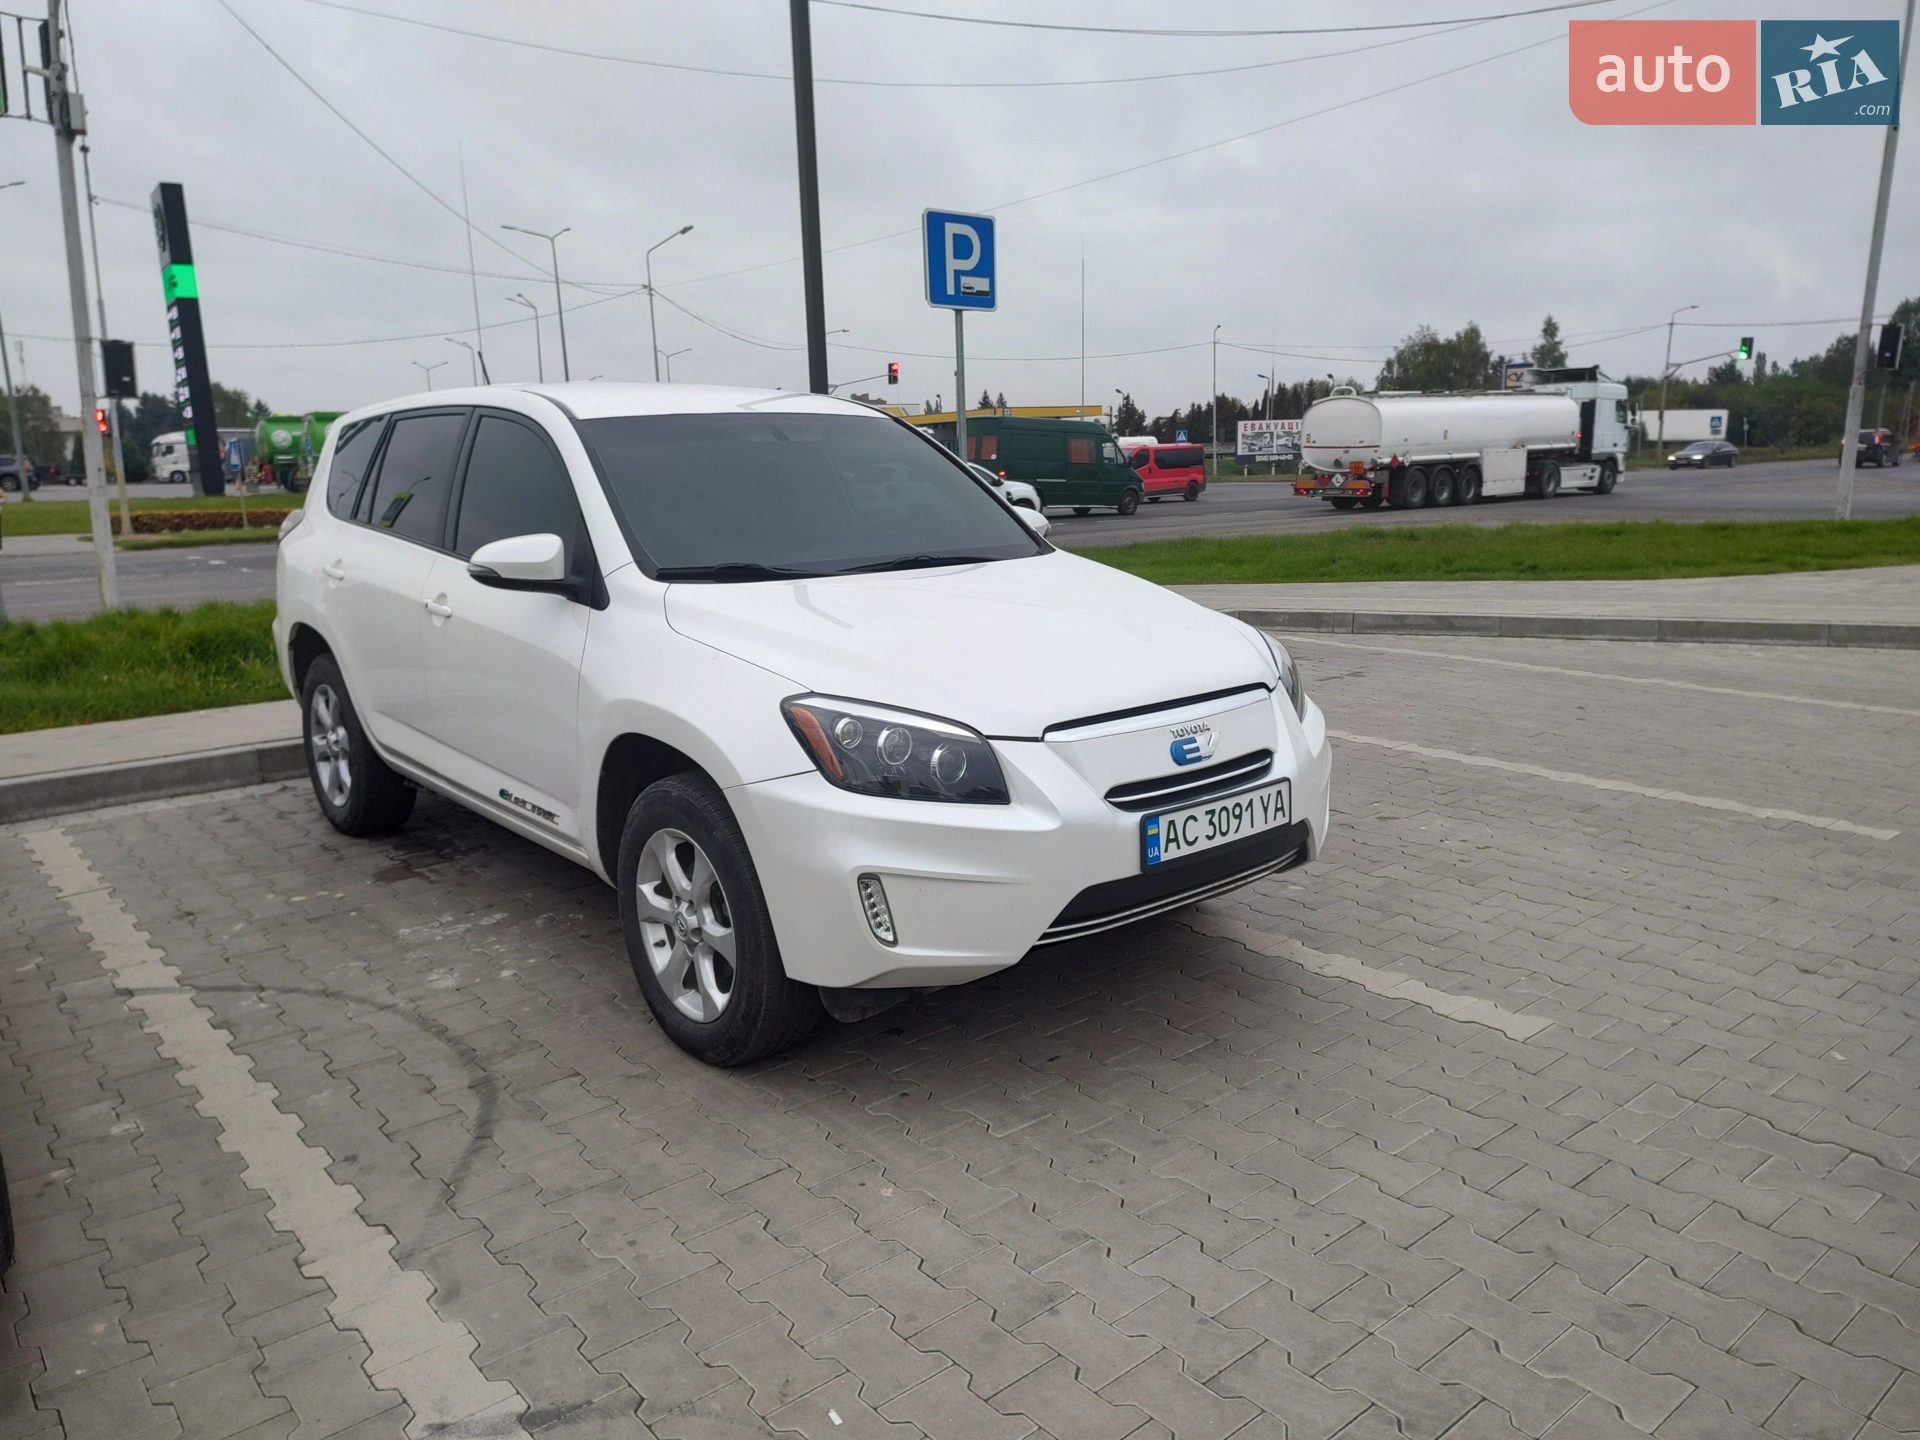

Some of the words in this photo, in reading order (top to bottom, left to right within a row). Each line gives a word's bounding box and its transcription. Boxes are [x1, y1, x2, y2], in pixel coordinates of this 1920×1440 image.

[944, 221, 981, 296] P
[1244, 422, 1299, 432] ЕВАКУАЦІ
[1169, 721, 1211, 739] TOYOTA
[1169, 730, 1220, 767] EV
[1163, 814, 1199, 853] AC
[1204, 798, 1255, 841] 3091
[1259, 789, 1286, 825] YA
[1147, 847, 1160, 858] UA
